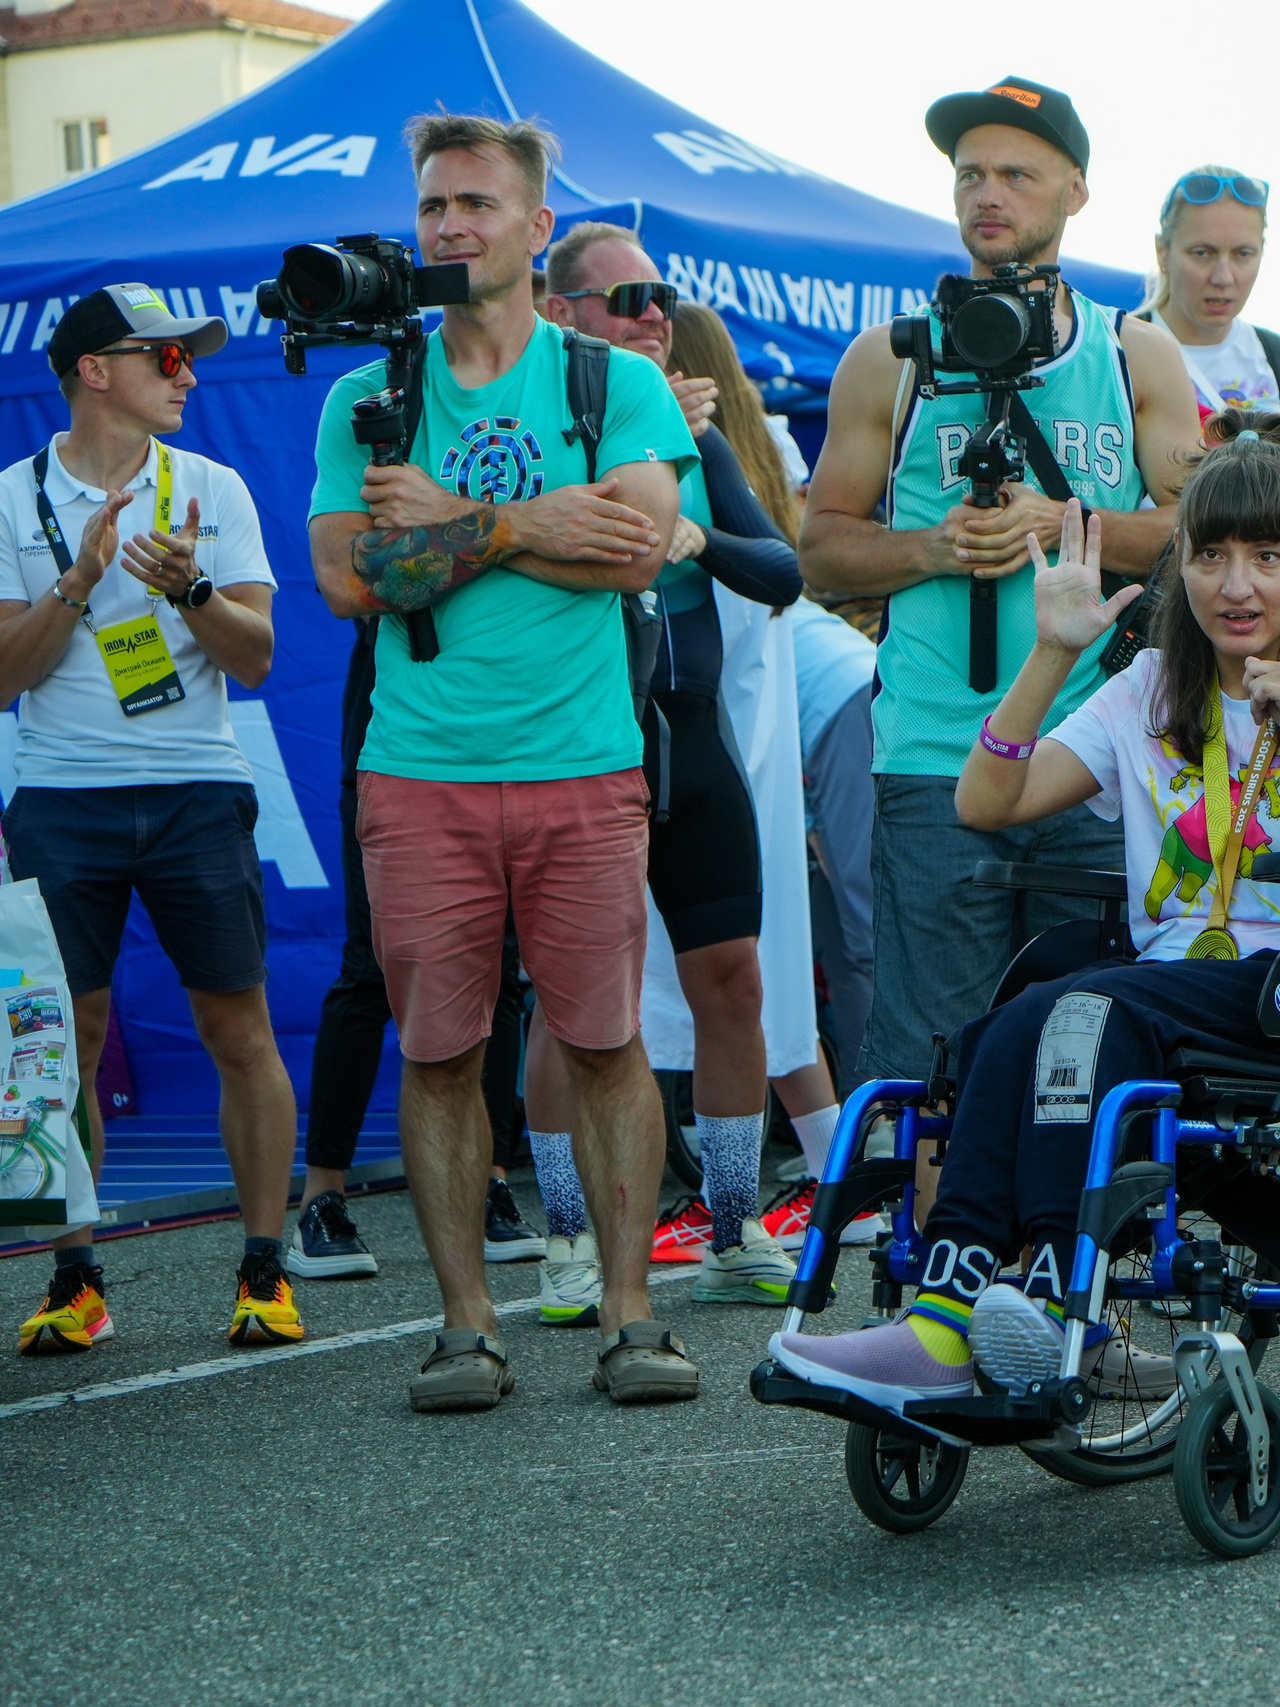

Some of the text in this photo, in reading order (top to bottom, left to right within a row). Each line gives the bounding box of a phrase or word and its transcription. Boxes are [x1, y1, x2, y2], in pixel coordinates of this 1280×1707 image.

[140, 133, 378, 191] AVA
[666, 252, 748, 315] AVA
[198, 525, 219, 538] STAR
[104, 638, 126, 653] IRON
[134, 628, 158, 643] STAR
[126, 695, 163, 711] ОРГАНИЗАТОР
[1253, 740, 1271, 772] SOCHI
[1242, 773, 1260, 806] SIRIUS
[1234, 808, 1248, 834] 2023
[922, 1239, 1002, 1298] OS
